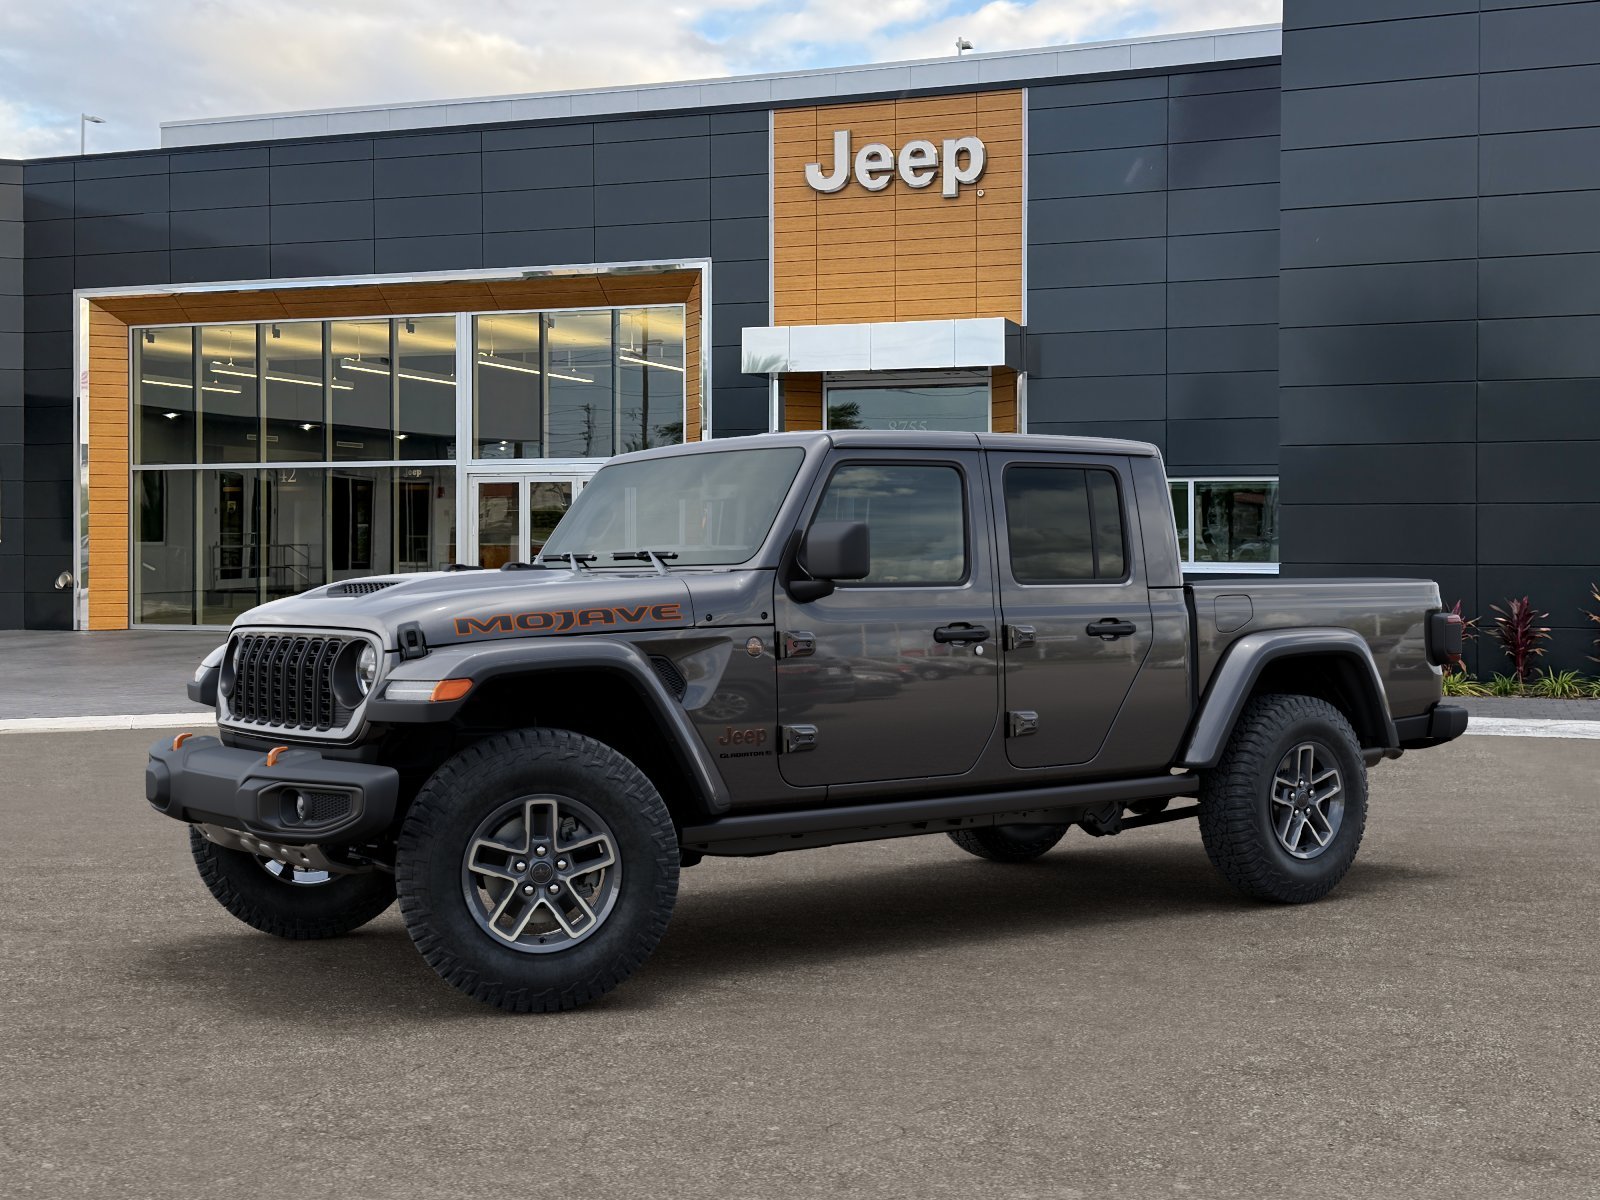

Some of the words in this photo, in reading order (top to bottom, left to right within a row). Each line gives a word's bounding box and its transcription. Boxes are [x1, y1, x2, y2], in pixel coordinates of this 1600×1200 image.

[804, 129, 986, 199] Jeep
[888, 420, 928, 431] 8755
[454, 604, 682, 636] MOJAVE
[718, 726, 767, 746] Jeep
